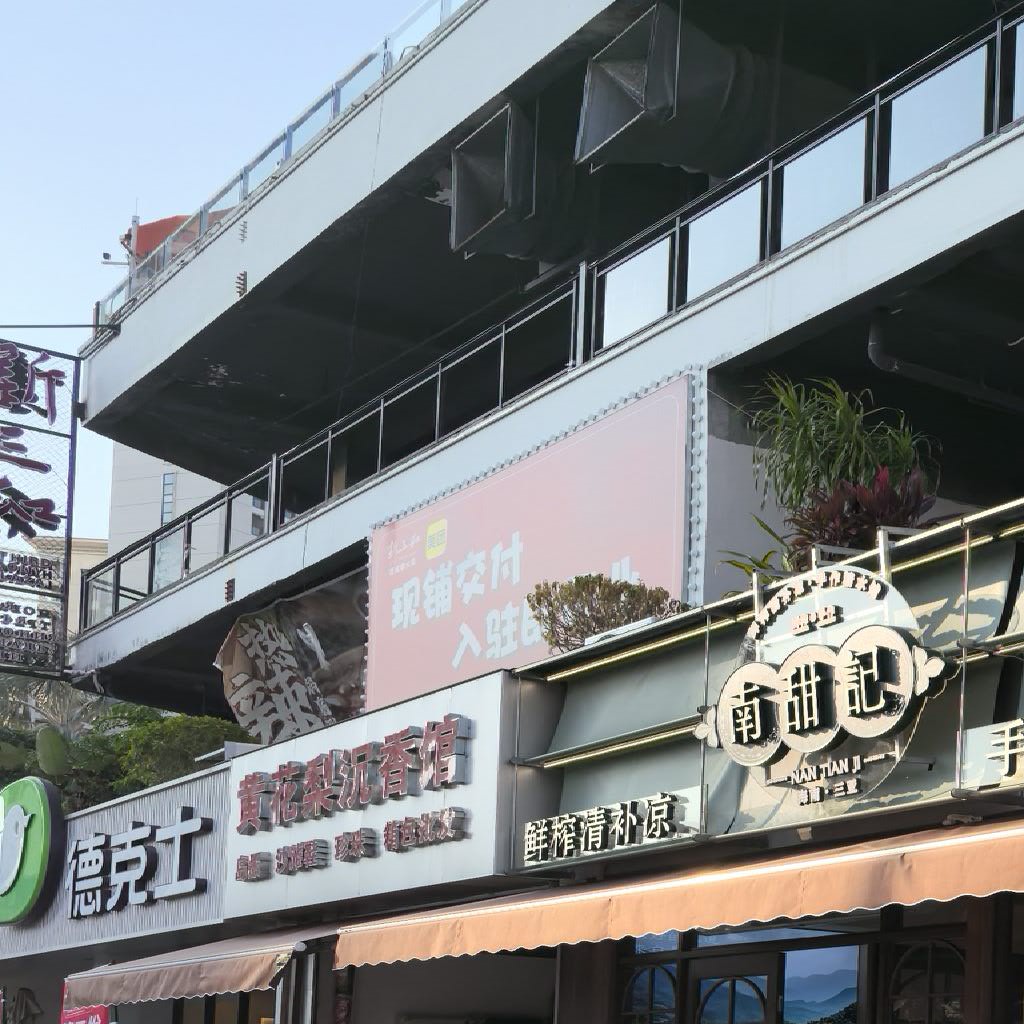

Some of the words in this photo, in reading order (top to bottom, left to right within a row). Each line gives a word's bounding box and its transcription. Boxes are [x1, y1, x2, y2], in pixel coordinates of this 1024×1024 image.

[391, 531, 524, 631] 现铺交付
[236, 713, 464, 836] 黄花梨沉香馆
[791, 765, 818, 785] NAN
[819, 757, 849, 779] TIAN
[851, 754, 862, 774] JI
[67, 807, 206, 920] 德克士
[523, 792, 676, 864] 鲜榨清补凉
